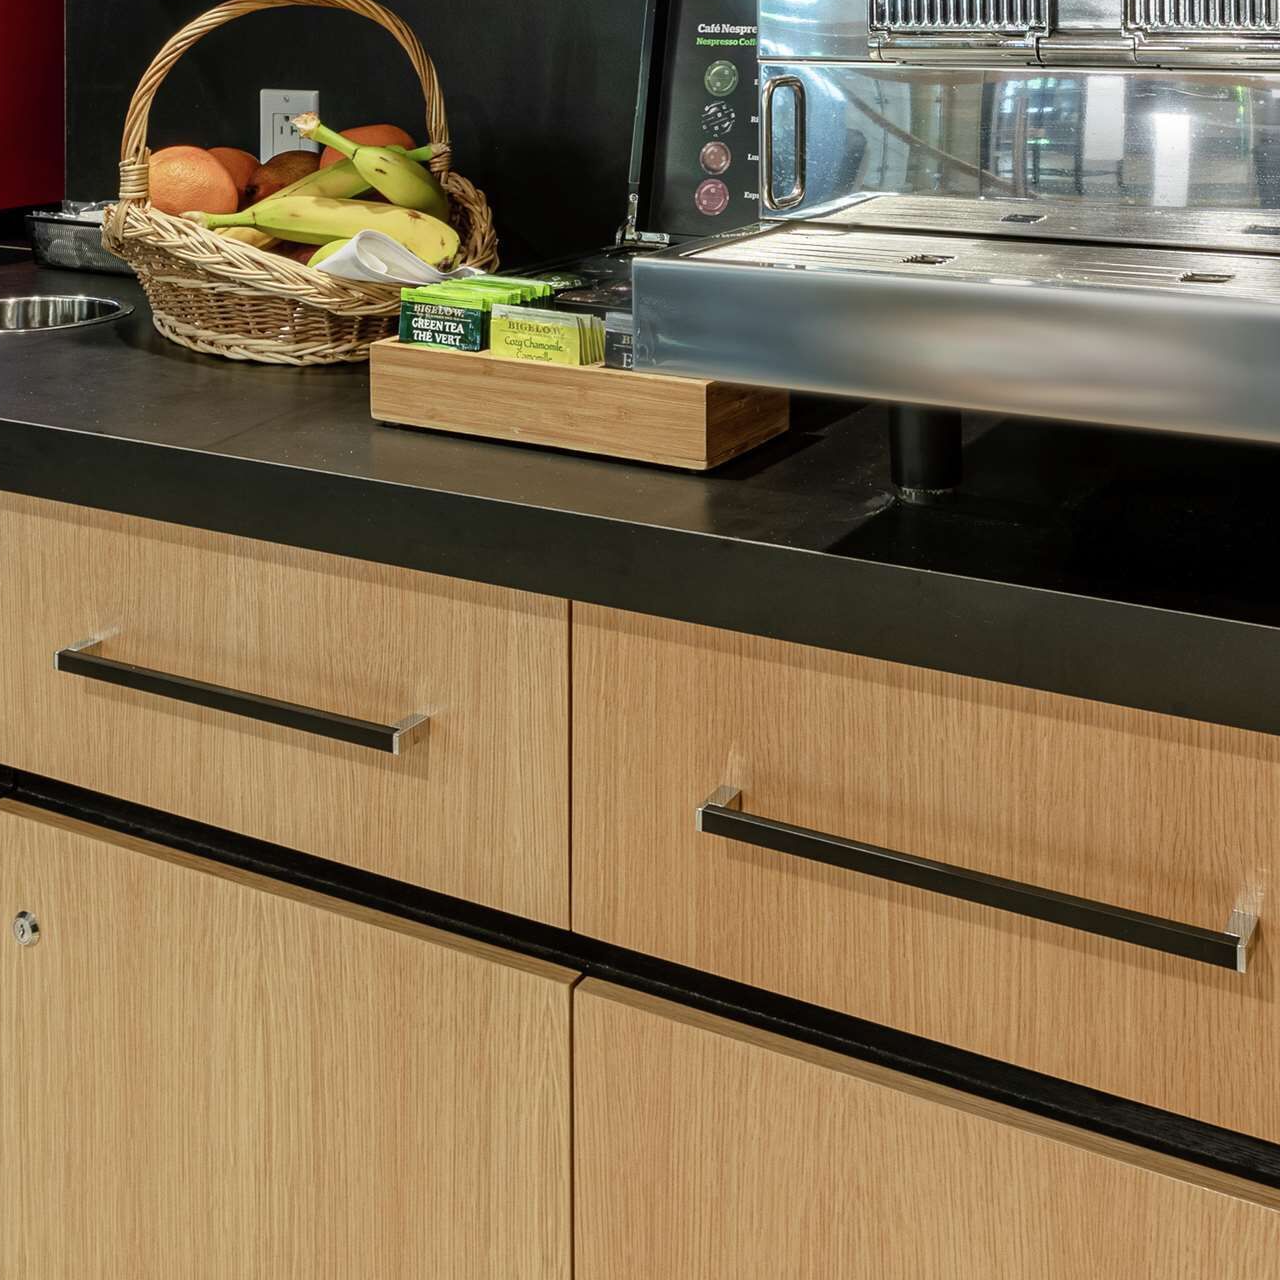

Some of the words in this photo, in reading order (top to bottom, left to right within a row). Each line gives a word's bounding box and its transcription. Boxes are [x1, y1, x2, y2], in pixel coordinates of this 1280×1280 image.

[698, 23, 720, 34] Café
[721, 23, 758, 36] Nespre
[696, 37, 738, 47] Nespresso
[738, 38, 758, 47] Coff
[412, 317, 443, 331] GREEN
[444, 321, 464, 334] TEA
[413, 330, 433, 342] THÉ
[435, 333, 462, 346] VERT
[504, 336, 523, 349] Cozy
